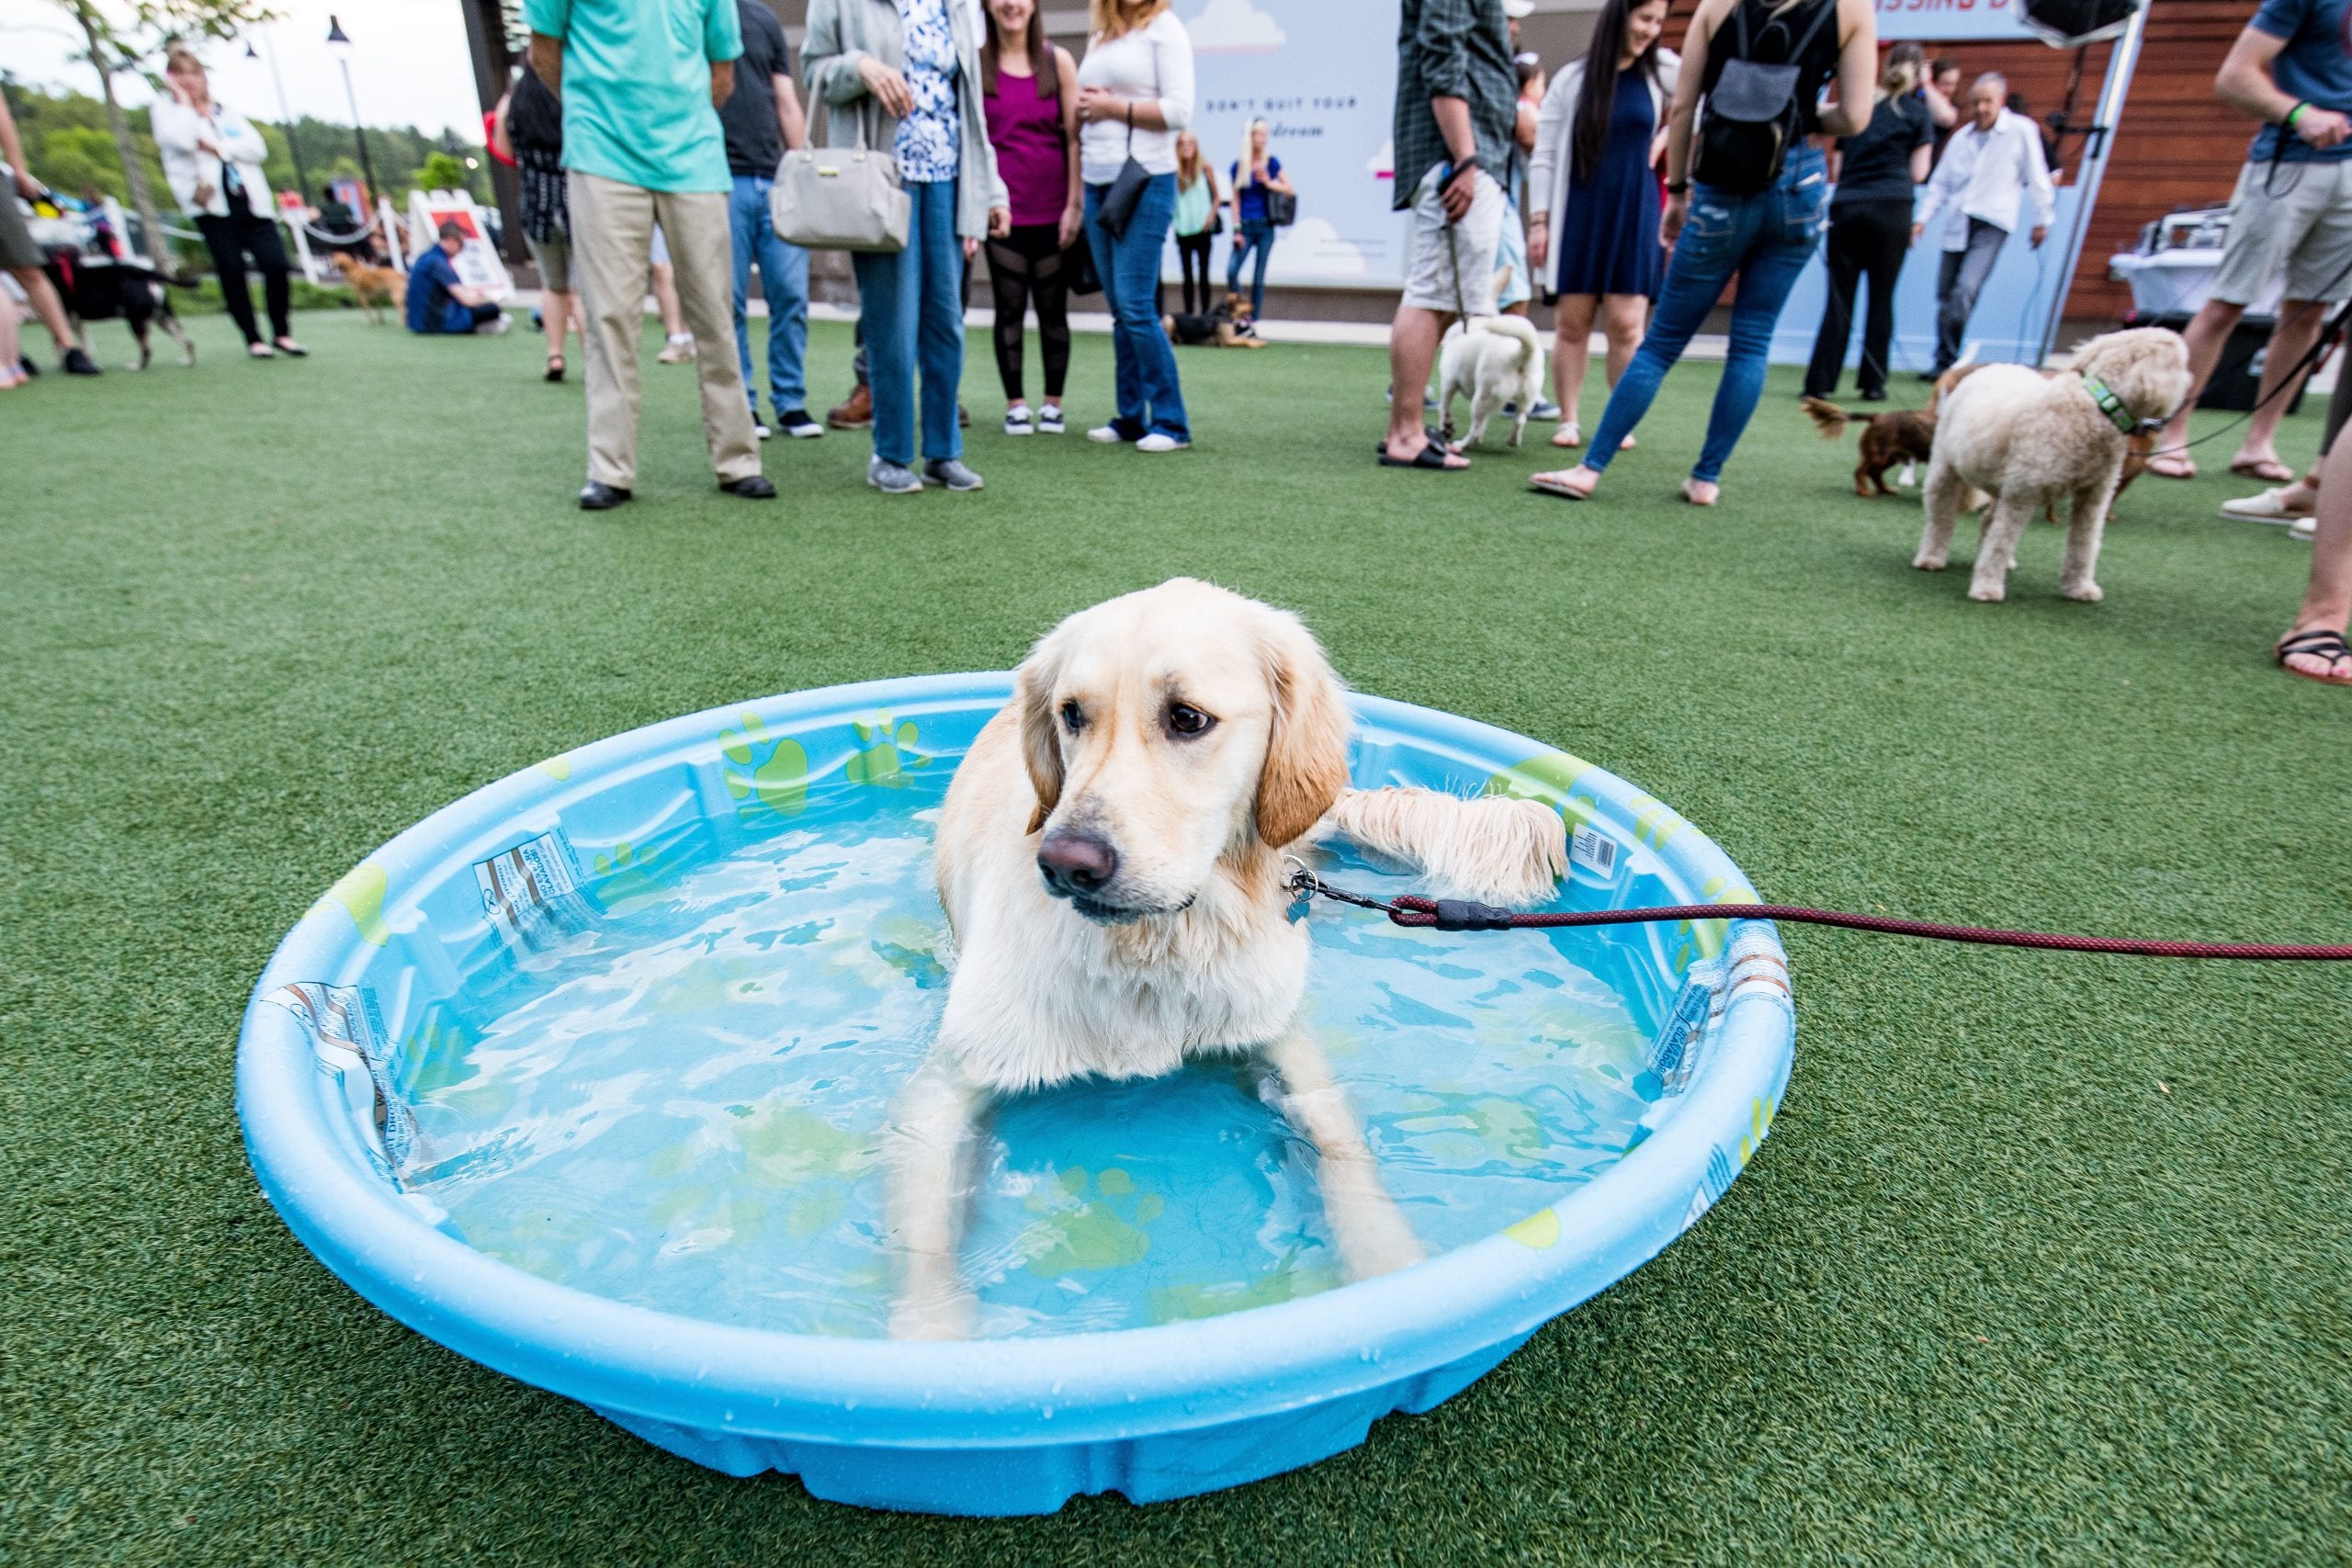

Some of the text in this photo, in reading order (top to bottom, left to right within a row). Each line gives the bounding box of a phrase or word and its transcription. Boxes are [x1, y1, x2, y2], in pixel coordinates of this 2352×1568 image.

[1205, 96, 1357, 112] DON'T QUIT YOUR
